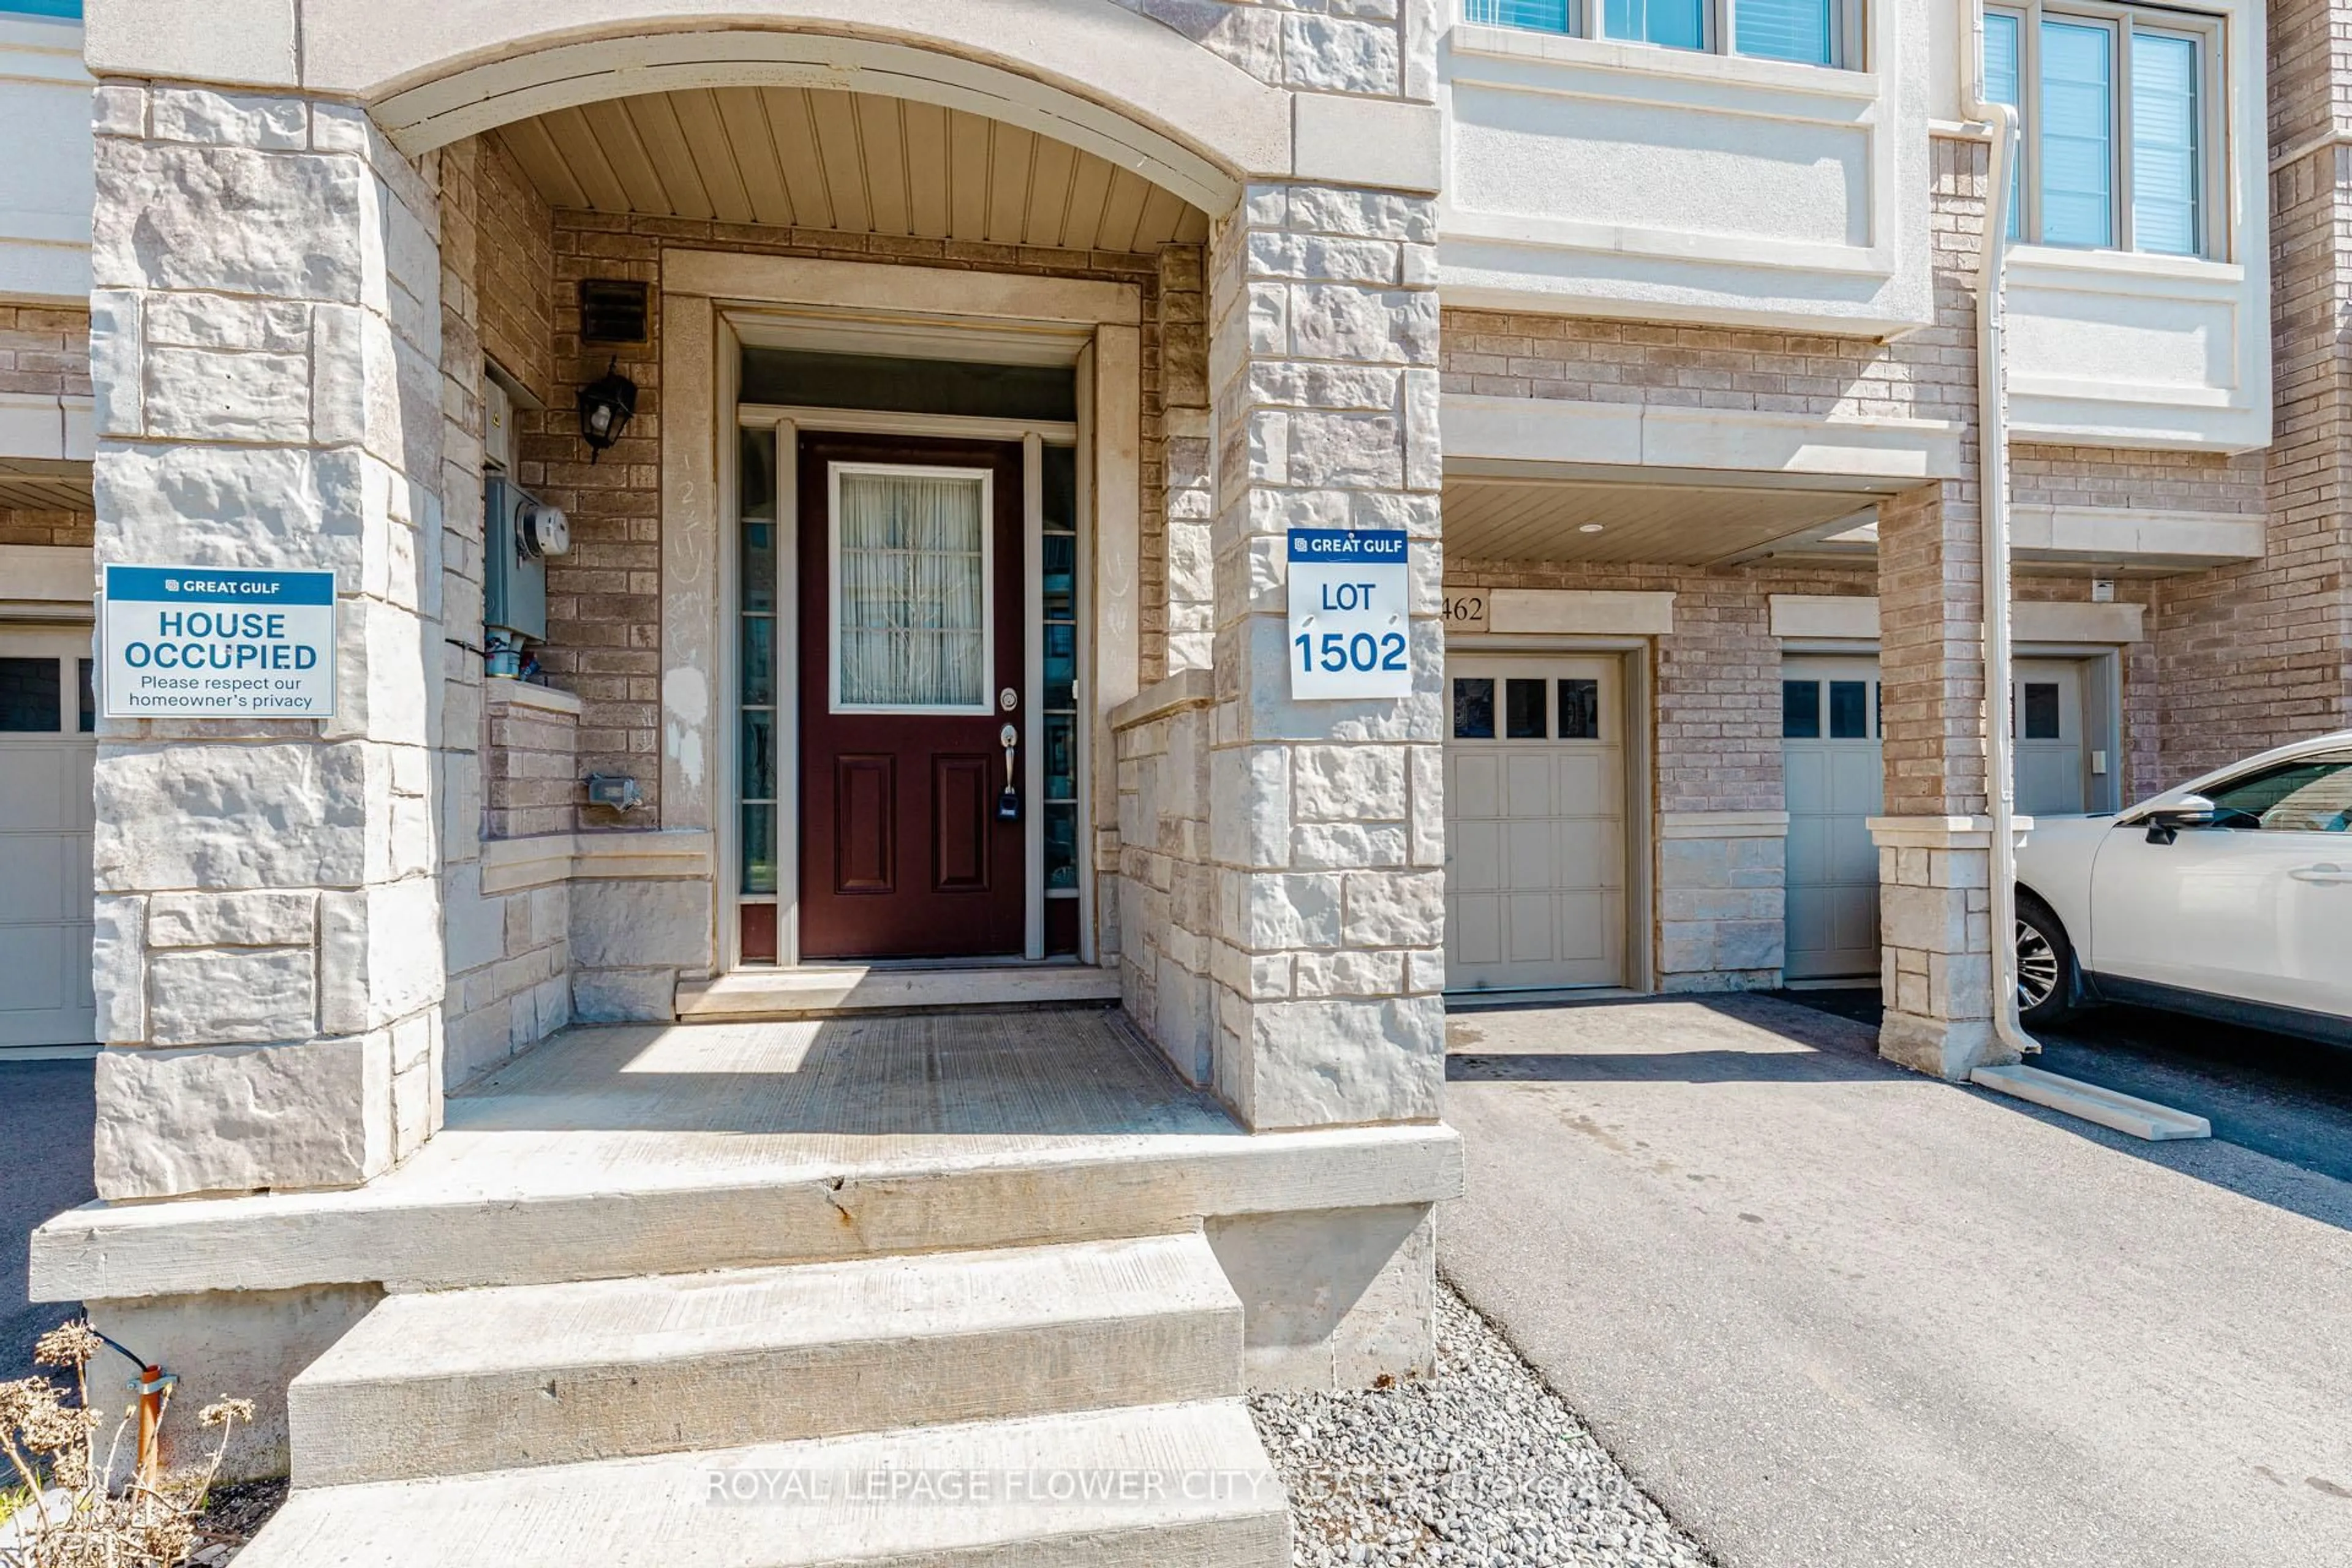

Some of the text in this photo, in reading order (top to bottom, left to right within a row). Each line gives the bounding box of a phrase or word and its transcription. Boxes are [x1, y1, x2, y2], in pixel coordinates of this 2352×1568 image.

[1311, 539, 1403, 552] GREAT GULF
[184, 580, 280, 594] GREAT GULF
[1322, 583, 1376, 610] LOT
[160, 611, 285, 638] HOUSE
[125, 641, 317, 669] OCCUPIED
[1295, 632, 1408, 672] 1502
[141, 676, 301, 692] Please respect our
[129, 693, 312, 710] homeowner's privacy
